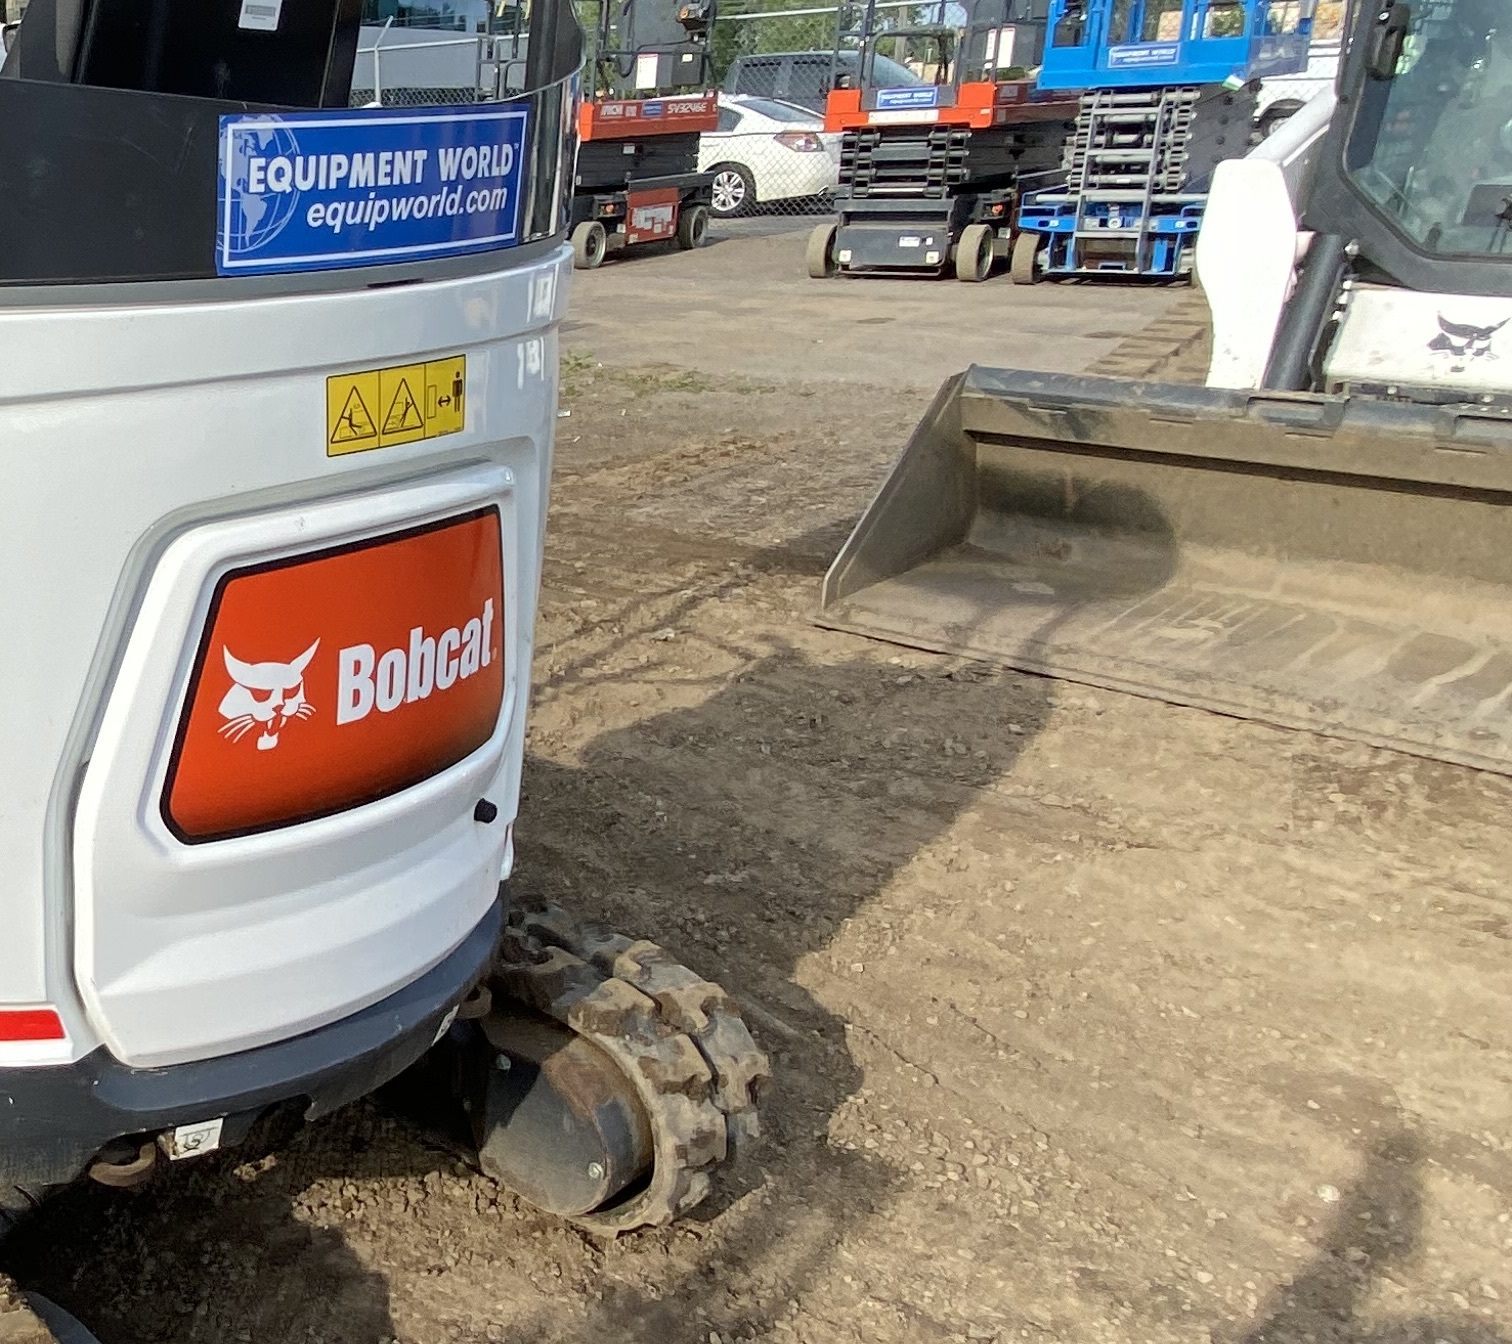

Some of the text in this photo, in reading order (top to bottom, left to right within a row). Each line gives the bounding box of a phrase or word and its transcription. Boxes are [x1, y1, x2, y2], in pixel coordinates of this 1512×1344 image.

[248, 149, 428, 194] EQUIPMENT
[306, 184, 508, 233] equipworld.com
[336, 598, 496, 726] Bobcat
